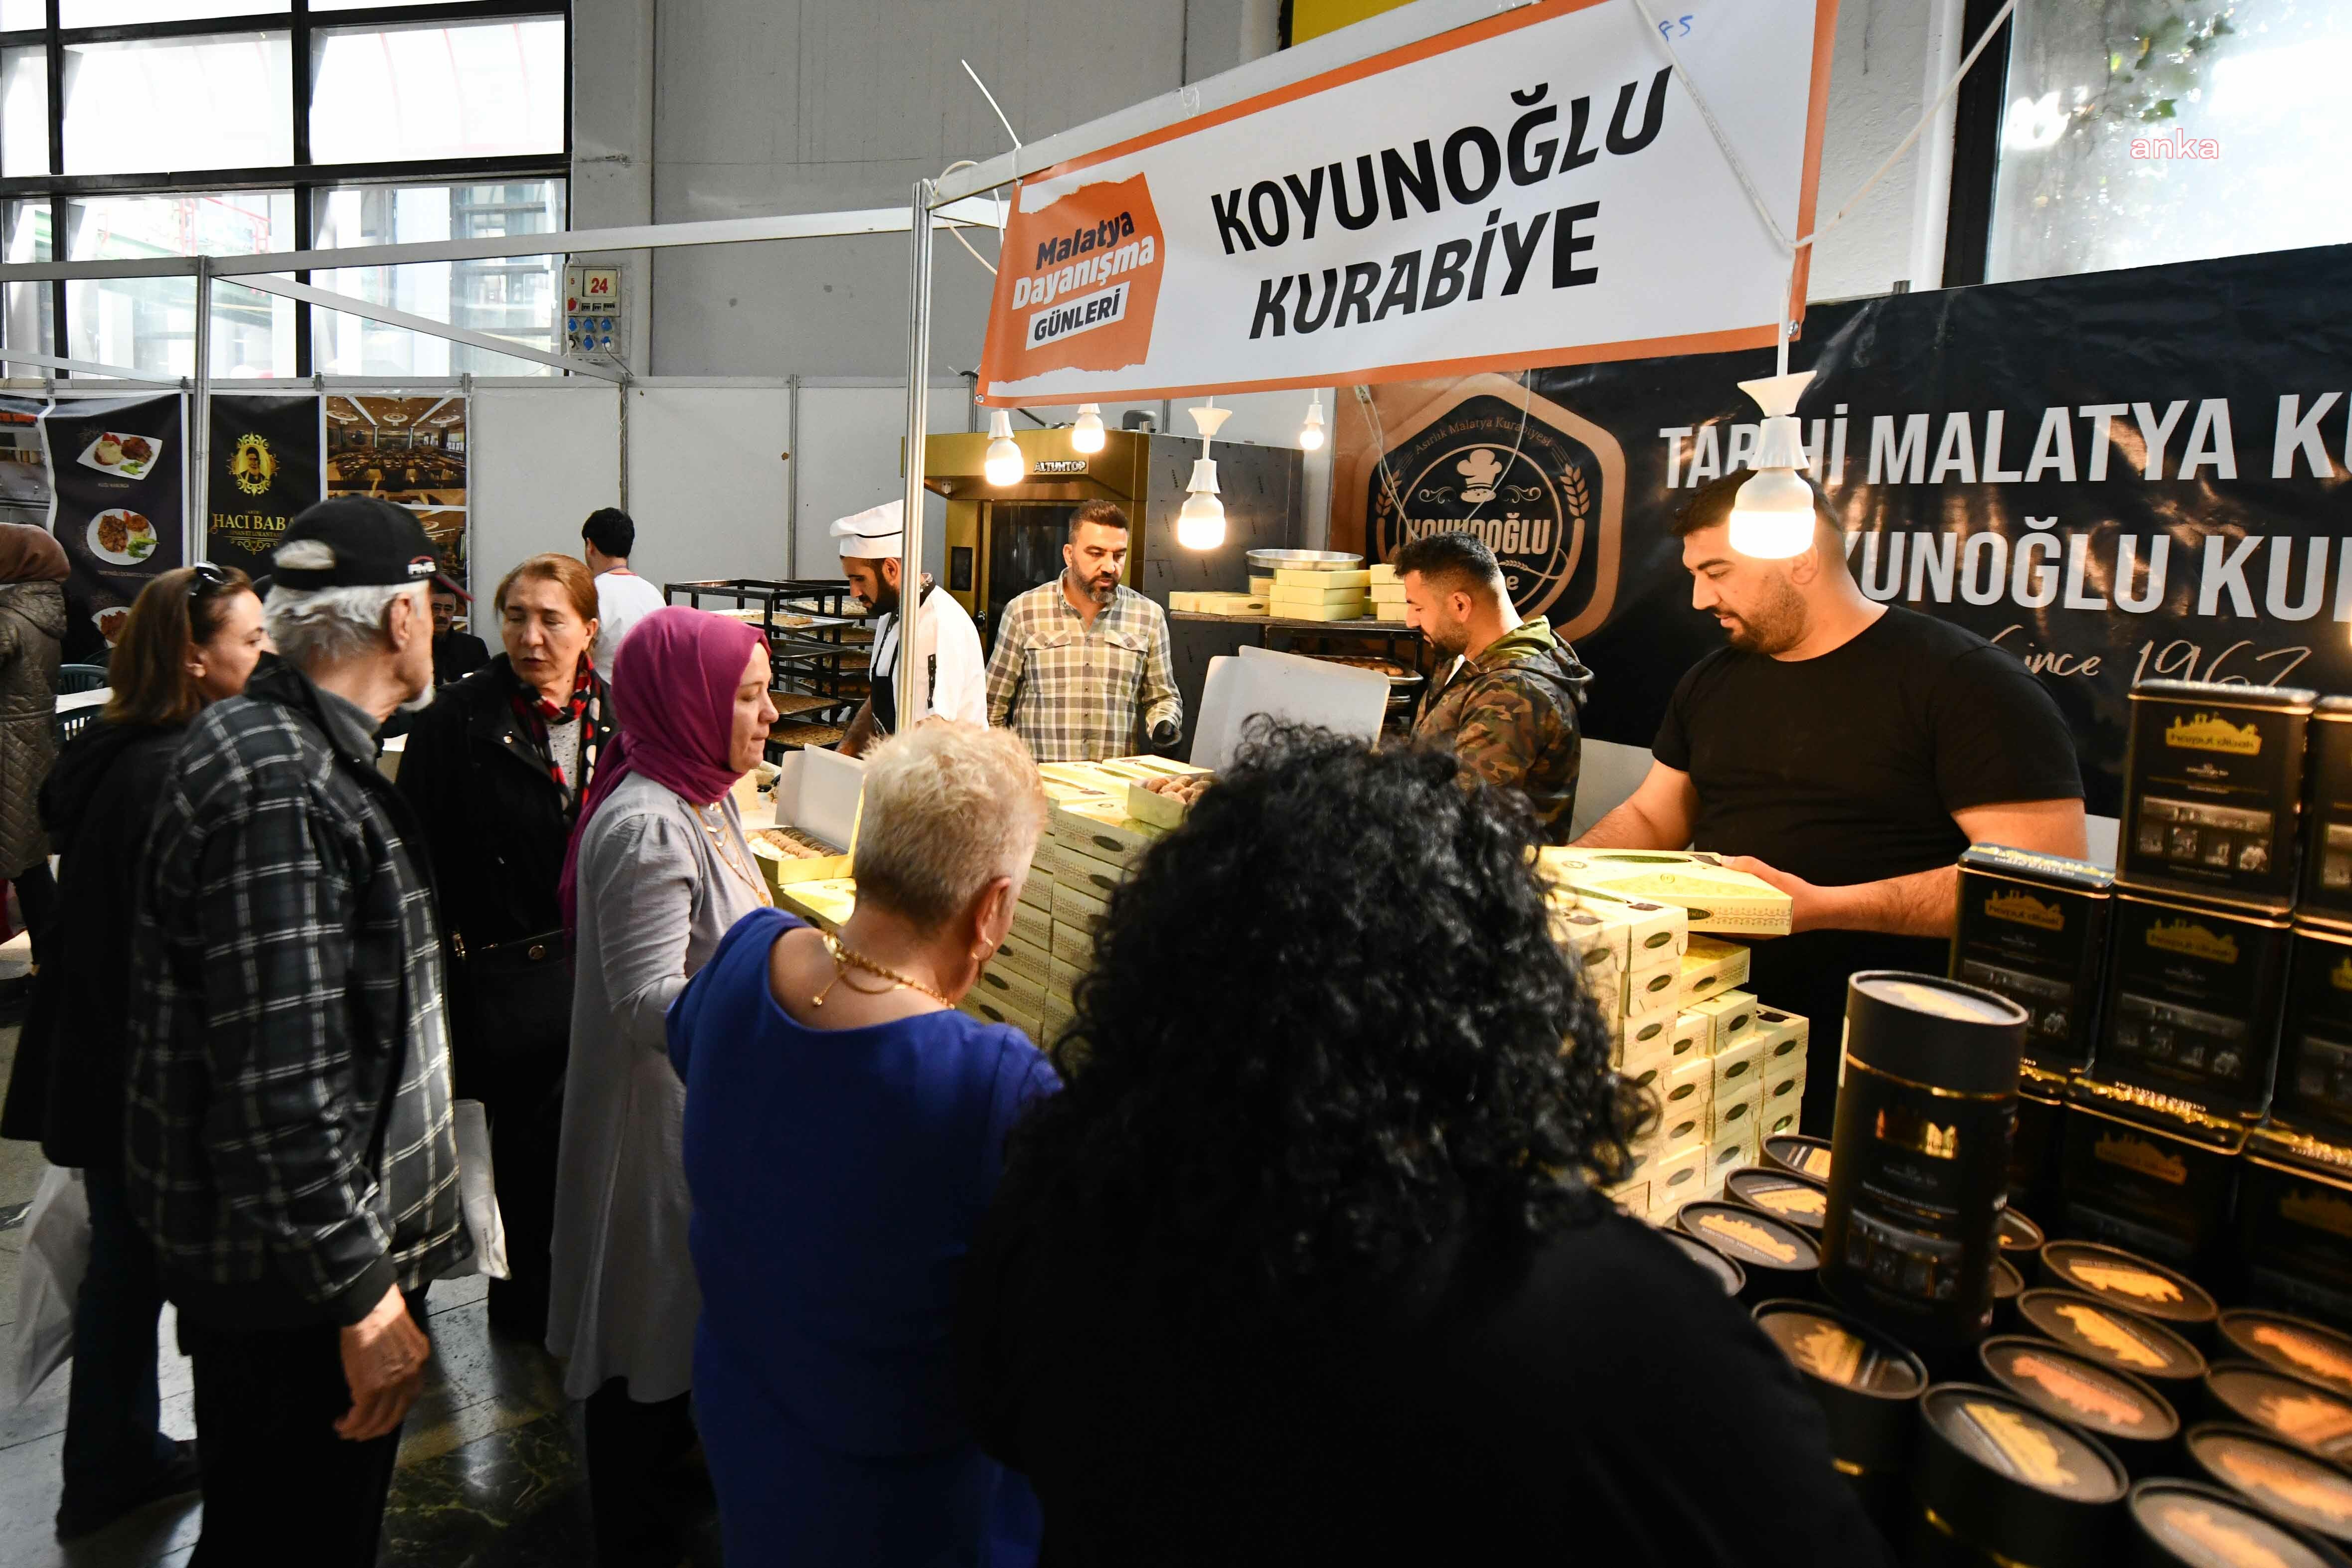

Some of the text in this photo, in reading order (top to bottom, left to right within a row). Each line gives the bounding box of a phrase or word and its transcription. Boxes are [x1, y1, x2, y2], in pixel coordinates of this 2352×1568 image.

[1211, 65, 1672, 254] KOYUNOĞLU
[1036, 211, 1135, 270] Malatya
[1249, 201, 1600, 339] KURABİYE
[591, 277, 608, 294] 24
[1012, 235, 1155, 311] Dayanışma
[1034, 288, 1121, 341] GÜNLERİ
[1415, 428, 1448, 455] Asırlık
[1448, 418, 1493, 435] Malatya
[1659, 403, 1849, 488] TARHİ
[1868, 398, 2237, 485] MALATYA
[213, 513, 250, 529] HACI
